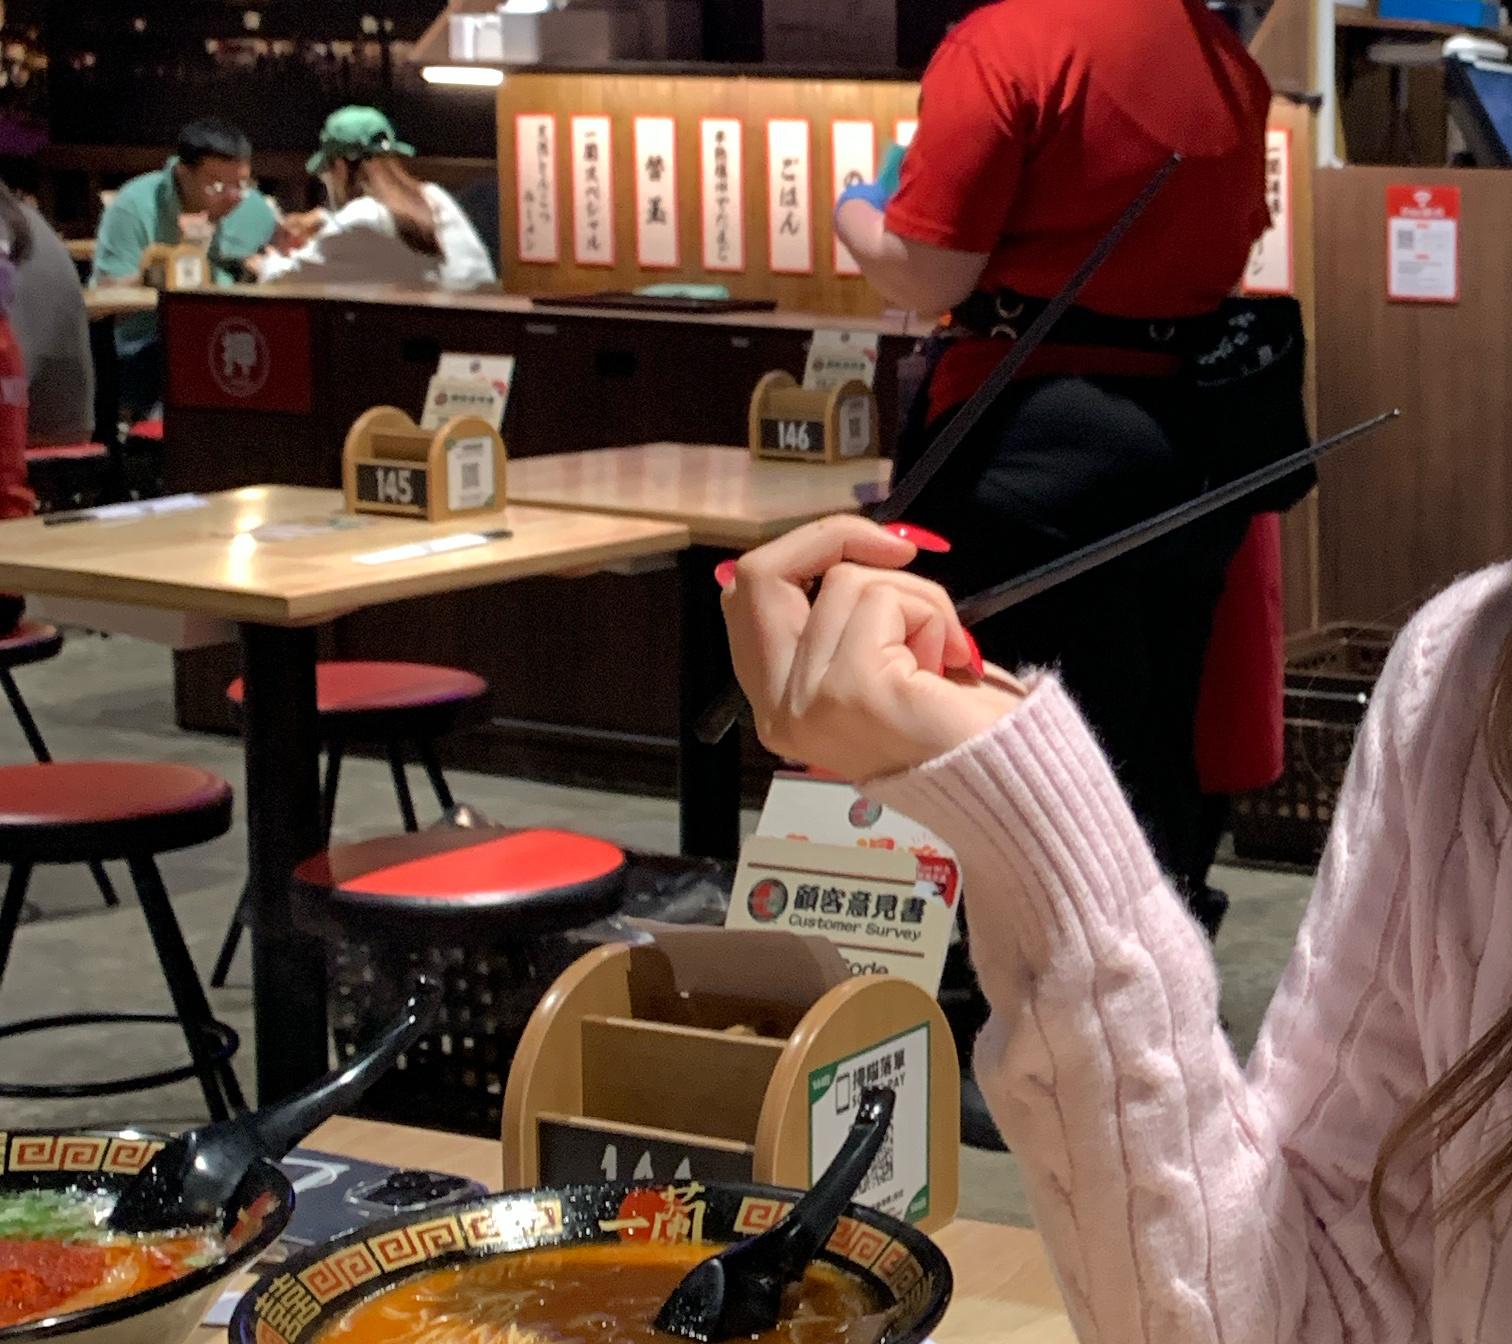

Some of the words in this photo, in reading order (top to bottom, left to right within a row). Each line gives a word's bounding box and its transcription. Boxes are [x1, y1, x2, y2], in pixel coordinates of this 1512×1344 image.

[779, 158, 800, 236] ごはん
[778, 420, 810, 451] 146
[376, 467, 414, 503] 145
[794, 883, 927, 925] 顧客意見書
[788, 912, 862, 935] Customer
[865, 922, 922, 942] Survey
[844, 958, 889, 976] ode
[598, 1181, 707, 1244] 一蘭
